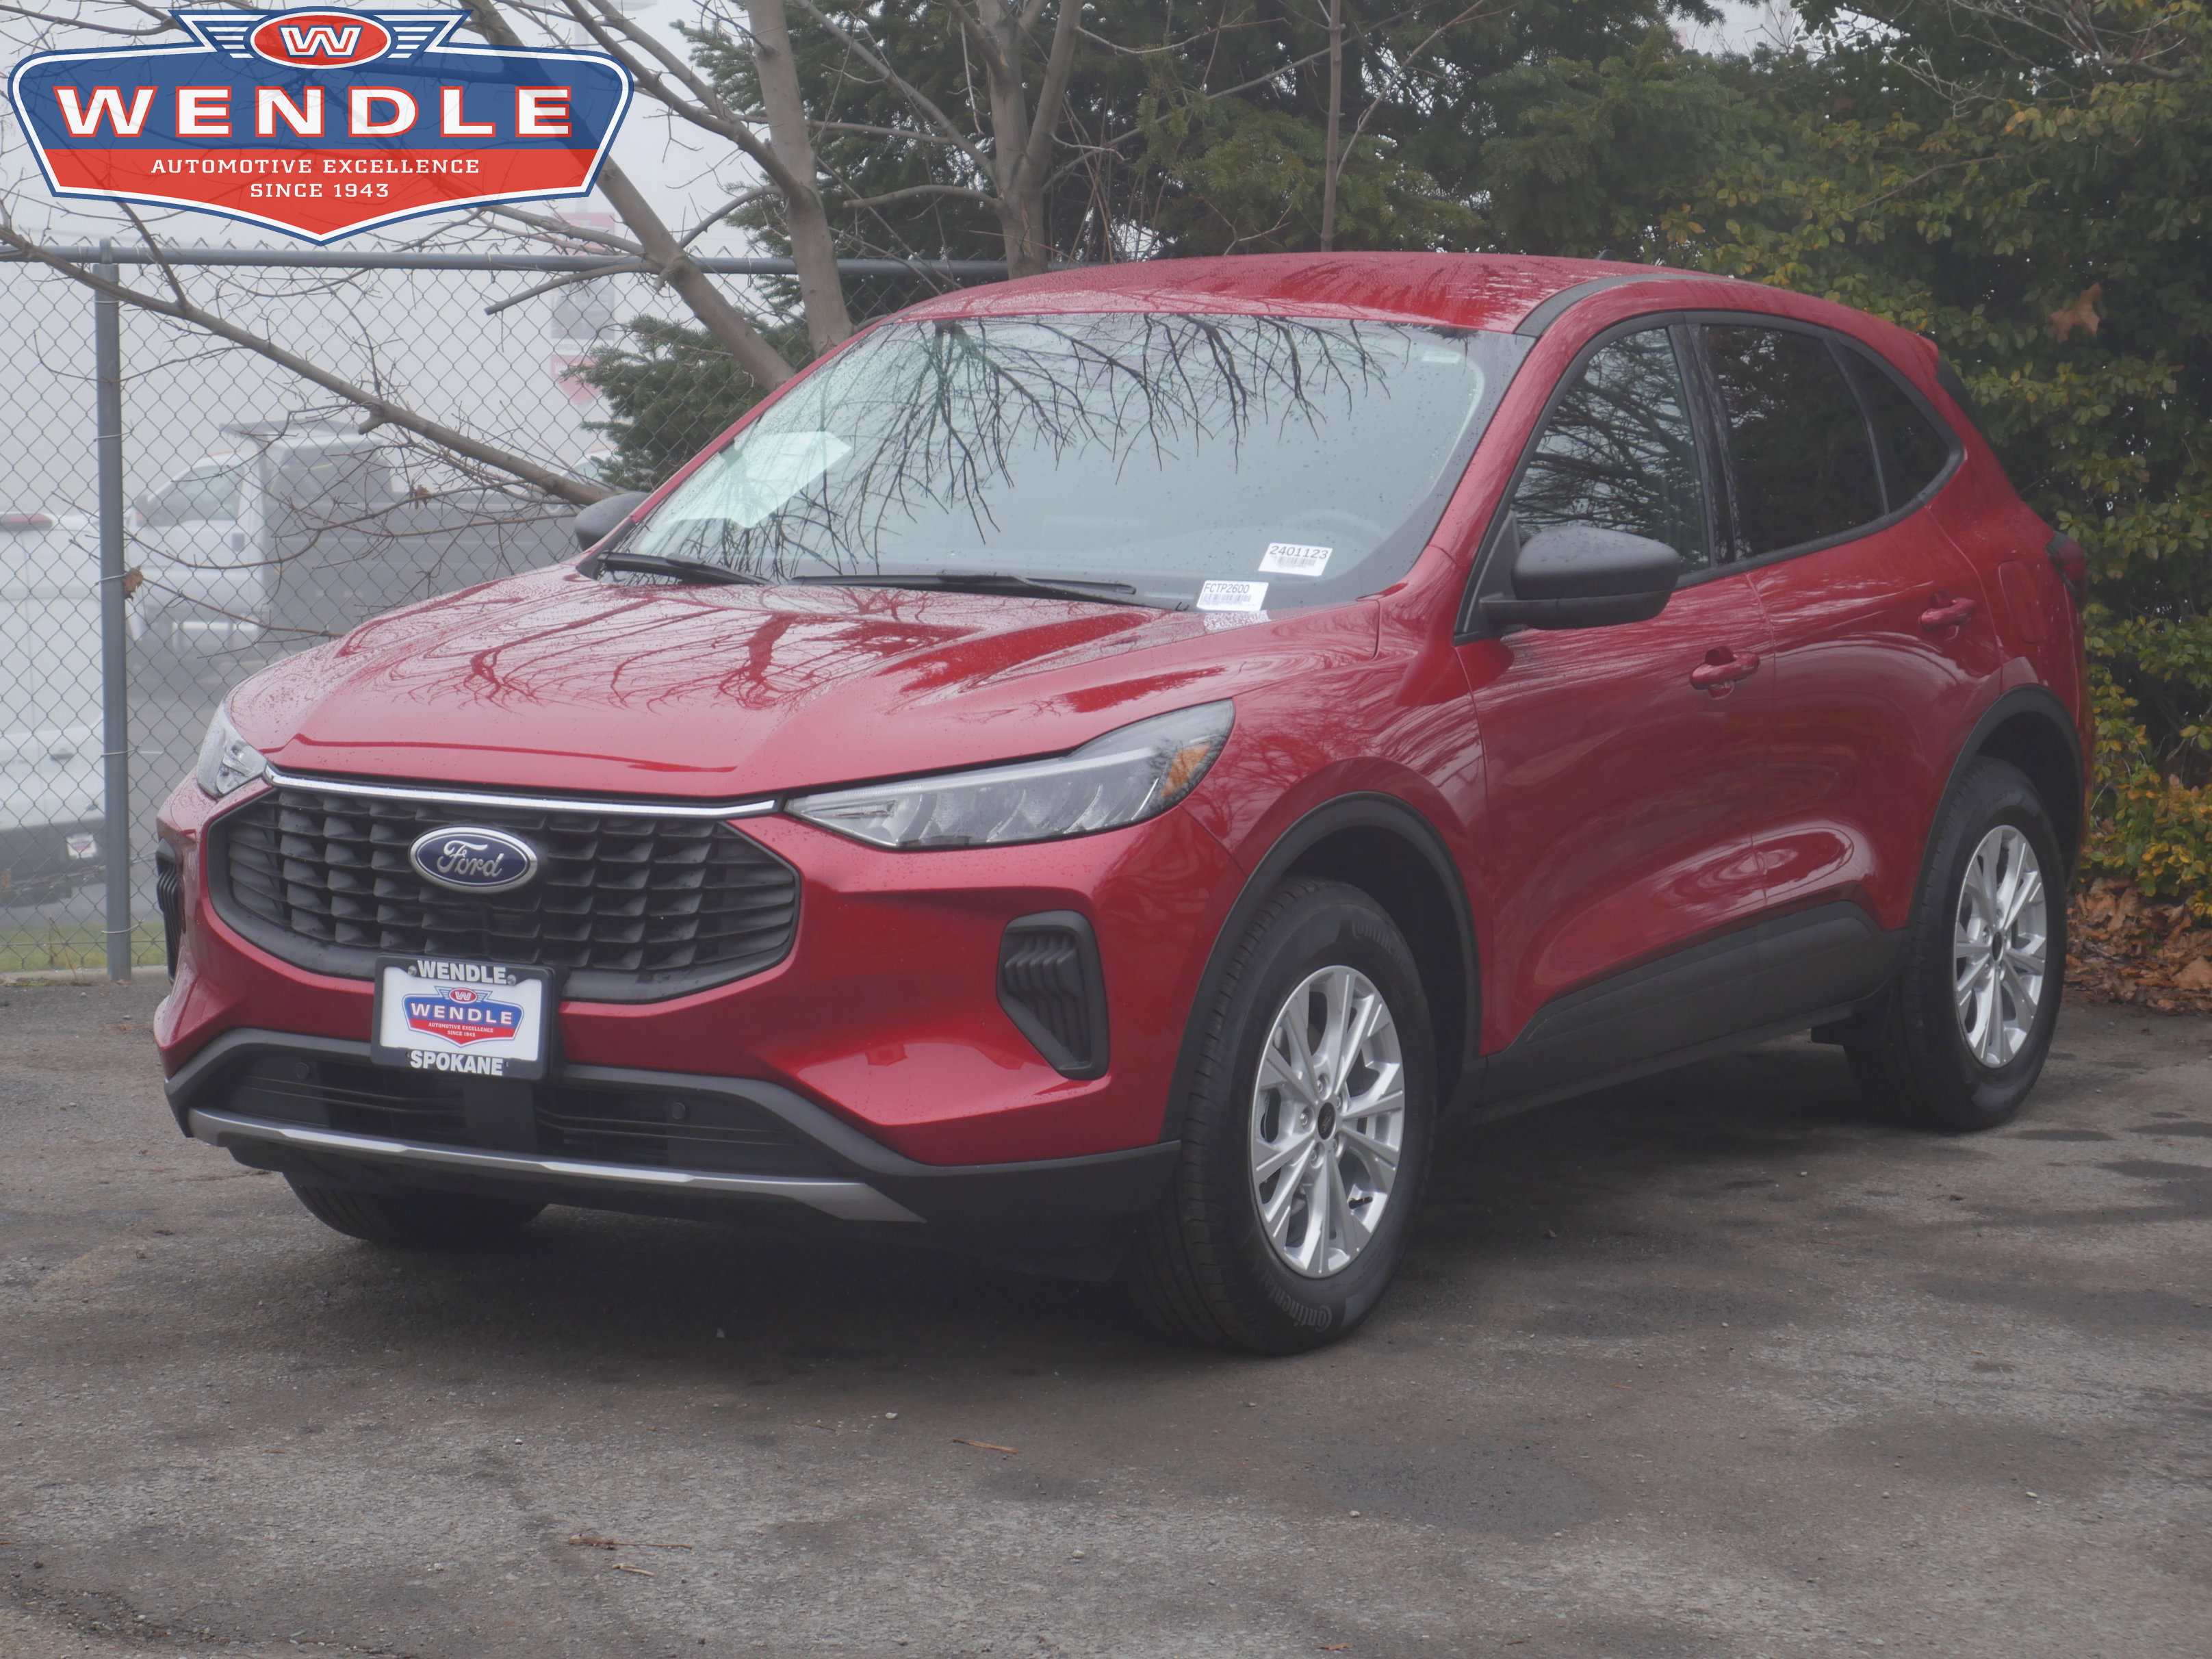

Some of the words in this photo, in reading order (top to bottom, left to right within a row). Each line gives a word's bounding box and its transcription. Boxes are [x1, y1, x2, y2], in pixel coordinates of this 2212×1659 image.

[1269, 545, 1329, 559] 2401123
[1203, 583, 1250, 594] FCTP2600
[436, 840, 504, 878] Ford
[417, 960, 506, 985] WENDLE
[411, 1003, 512, 1025] WENDLE
[428, 1022, 461, 1030] AUTOMOTIVE
[410, 1050, 503, 1077] SPOKANE
